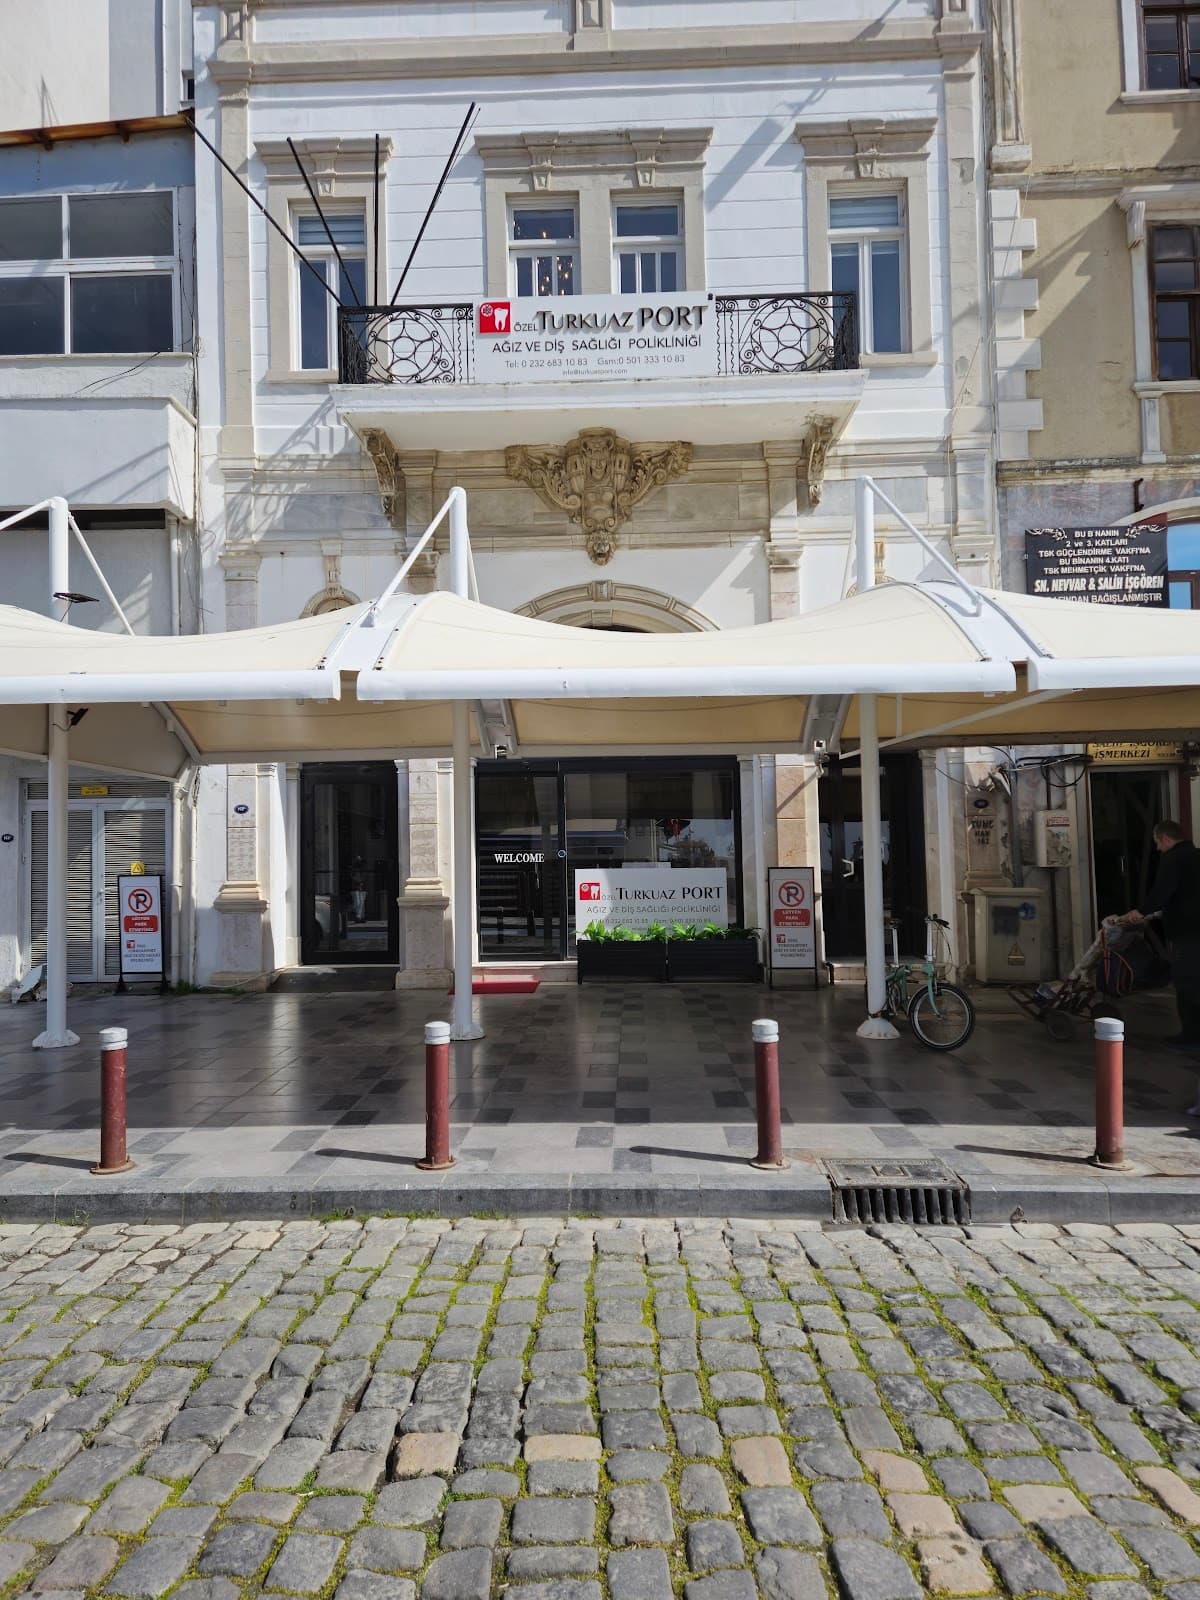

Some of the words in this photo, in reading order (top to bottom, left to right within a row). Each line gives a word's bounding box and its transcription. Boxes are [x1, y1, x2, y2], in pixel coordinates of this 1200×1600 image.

[513, 321, 538, 332] ÖZEL
[535, 310, 634, 330] TURKUAZ
[640, 305, 708, 327] PORT
[492, 340, 522, 353] AĞIZ
[525, 340, 541, 352] VE
[545, 338, 565, 353] DİŞ
[572, 336, 621, 350] SAĞLIĞI
[628, 335, 701, 349] POLİKLİNİĞİ
[521, 360, 527, 368] 0
[530, 360, 545, 368] 232
[547, 359, 562, 367] 683
[566, 358, 575, 366] 10
[577, 358, 588, 366] 83
[626, 356, 641, 364] 501
[644, 355, 660, 363] 333
[662, 355, 673, 363] 10
[674, 354, 685, 362] 83
[1074, 530, 1085, 538] BU
[1086, 539, 1094, 547] 3.
[1095, 538, 1128, 546] KATLARI
[1039, 550, 1055, 558] TSK
[1056, 547, 1112, 558] GÜÇLENDİRME
[1059, 558, 1070, 566] BU
[1072, 557, 1104, 565] BİNANIN
[1044, 567, 1059, 575] TSK
[1060, 565, 1107, 575] MEHMETÇİK
[1034, 579, 1050, 593] SN.
[1051, 578, 1087, 592] NEVVAR
[1088, 579, 1096, 590] &
[1098, 574, 1123, 590] SALİH
[1125, 573, 1164, 593] İŞGÖREN
[494, 853, 545, 864] WELCOME
[616, 887, 677, 900] TURKUAZ
[682, 886, 723, 900] PORT
[622, 905, 635, 914] DİŞ
